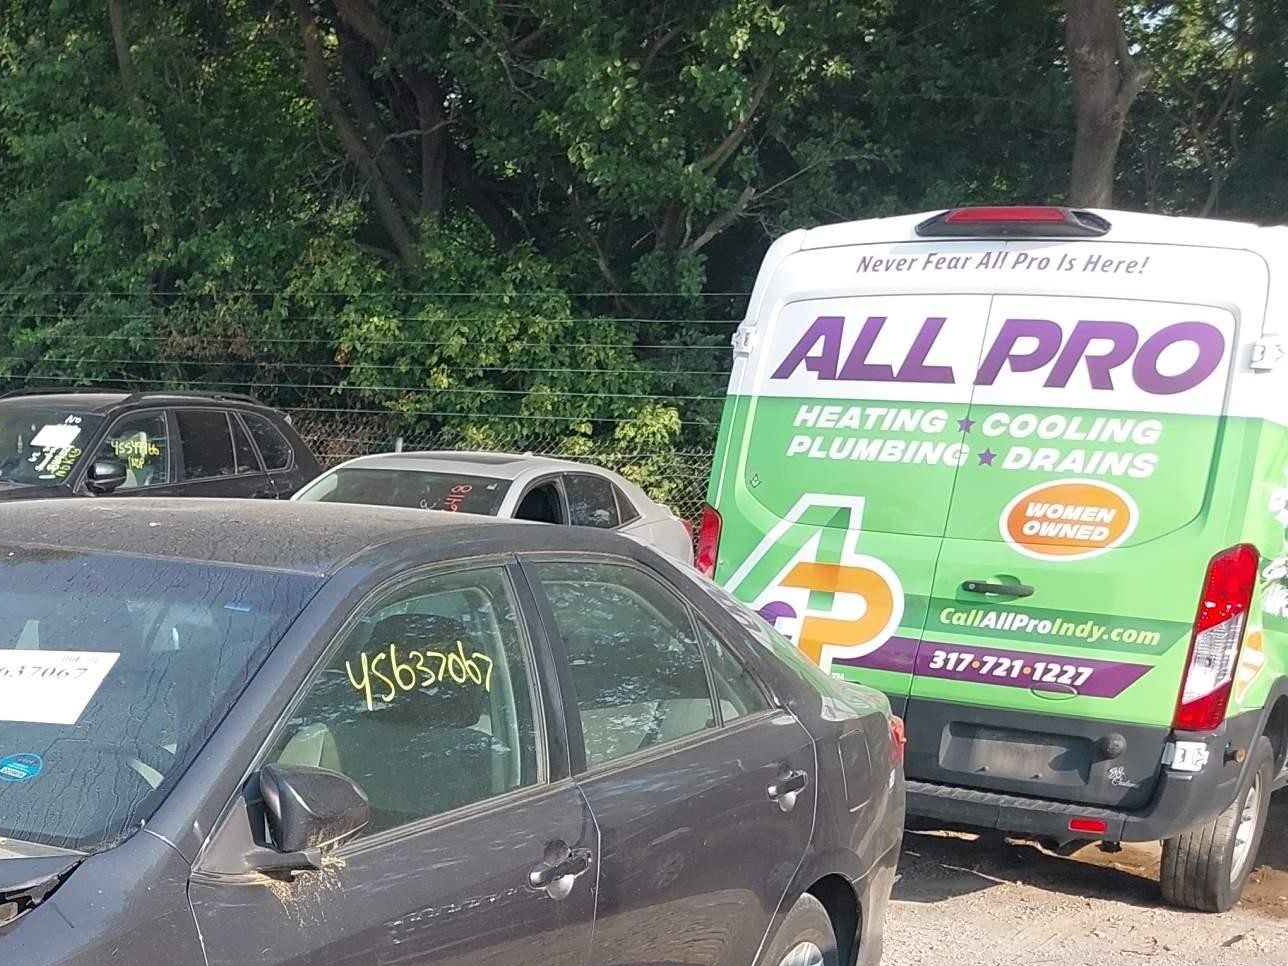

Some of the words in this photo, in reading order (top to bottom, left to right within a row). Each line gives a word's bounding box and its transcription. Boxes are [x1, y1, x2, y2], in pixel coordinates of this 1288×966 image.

[856, 255, 918, 273] Never
[922, 252, 972, 271] Fear
[976, 250, 1009, 270] All
[1012, 252, 1050, 271] Pro
[1056, 253, 1077, 271] Is
[1082, 254, 1150, 274] Here!
[770, 316, 955, 384] ALL
[973, 318, 1225, 395] PRO
[793, 404, 948, 432] HEATING
[982, 412, 1163, 445] COOLING
[786, 435, 968, 467] PLUMBING
[1001, 447, 1159, 478] DRAINS
[1022, 520, 1110, 541] OWNED
[1025, 502, 1117, 523] WOMEN
[940, 607, 1161, 646] CallAllProIndy.com
[346, 640, 493, 711] 45637067
